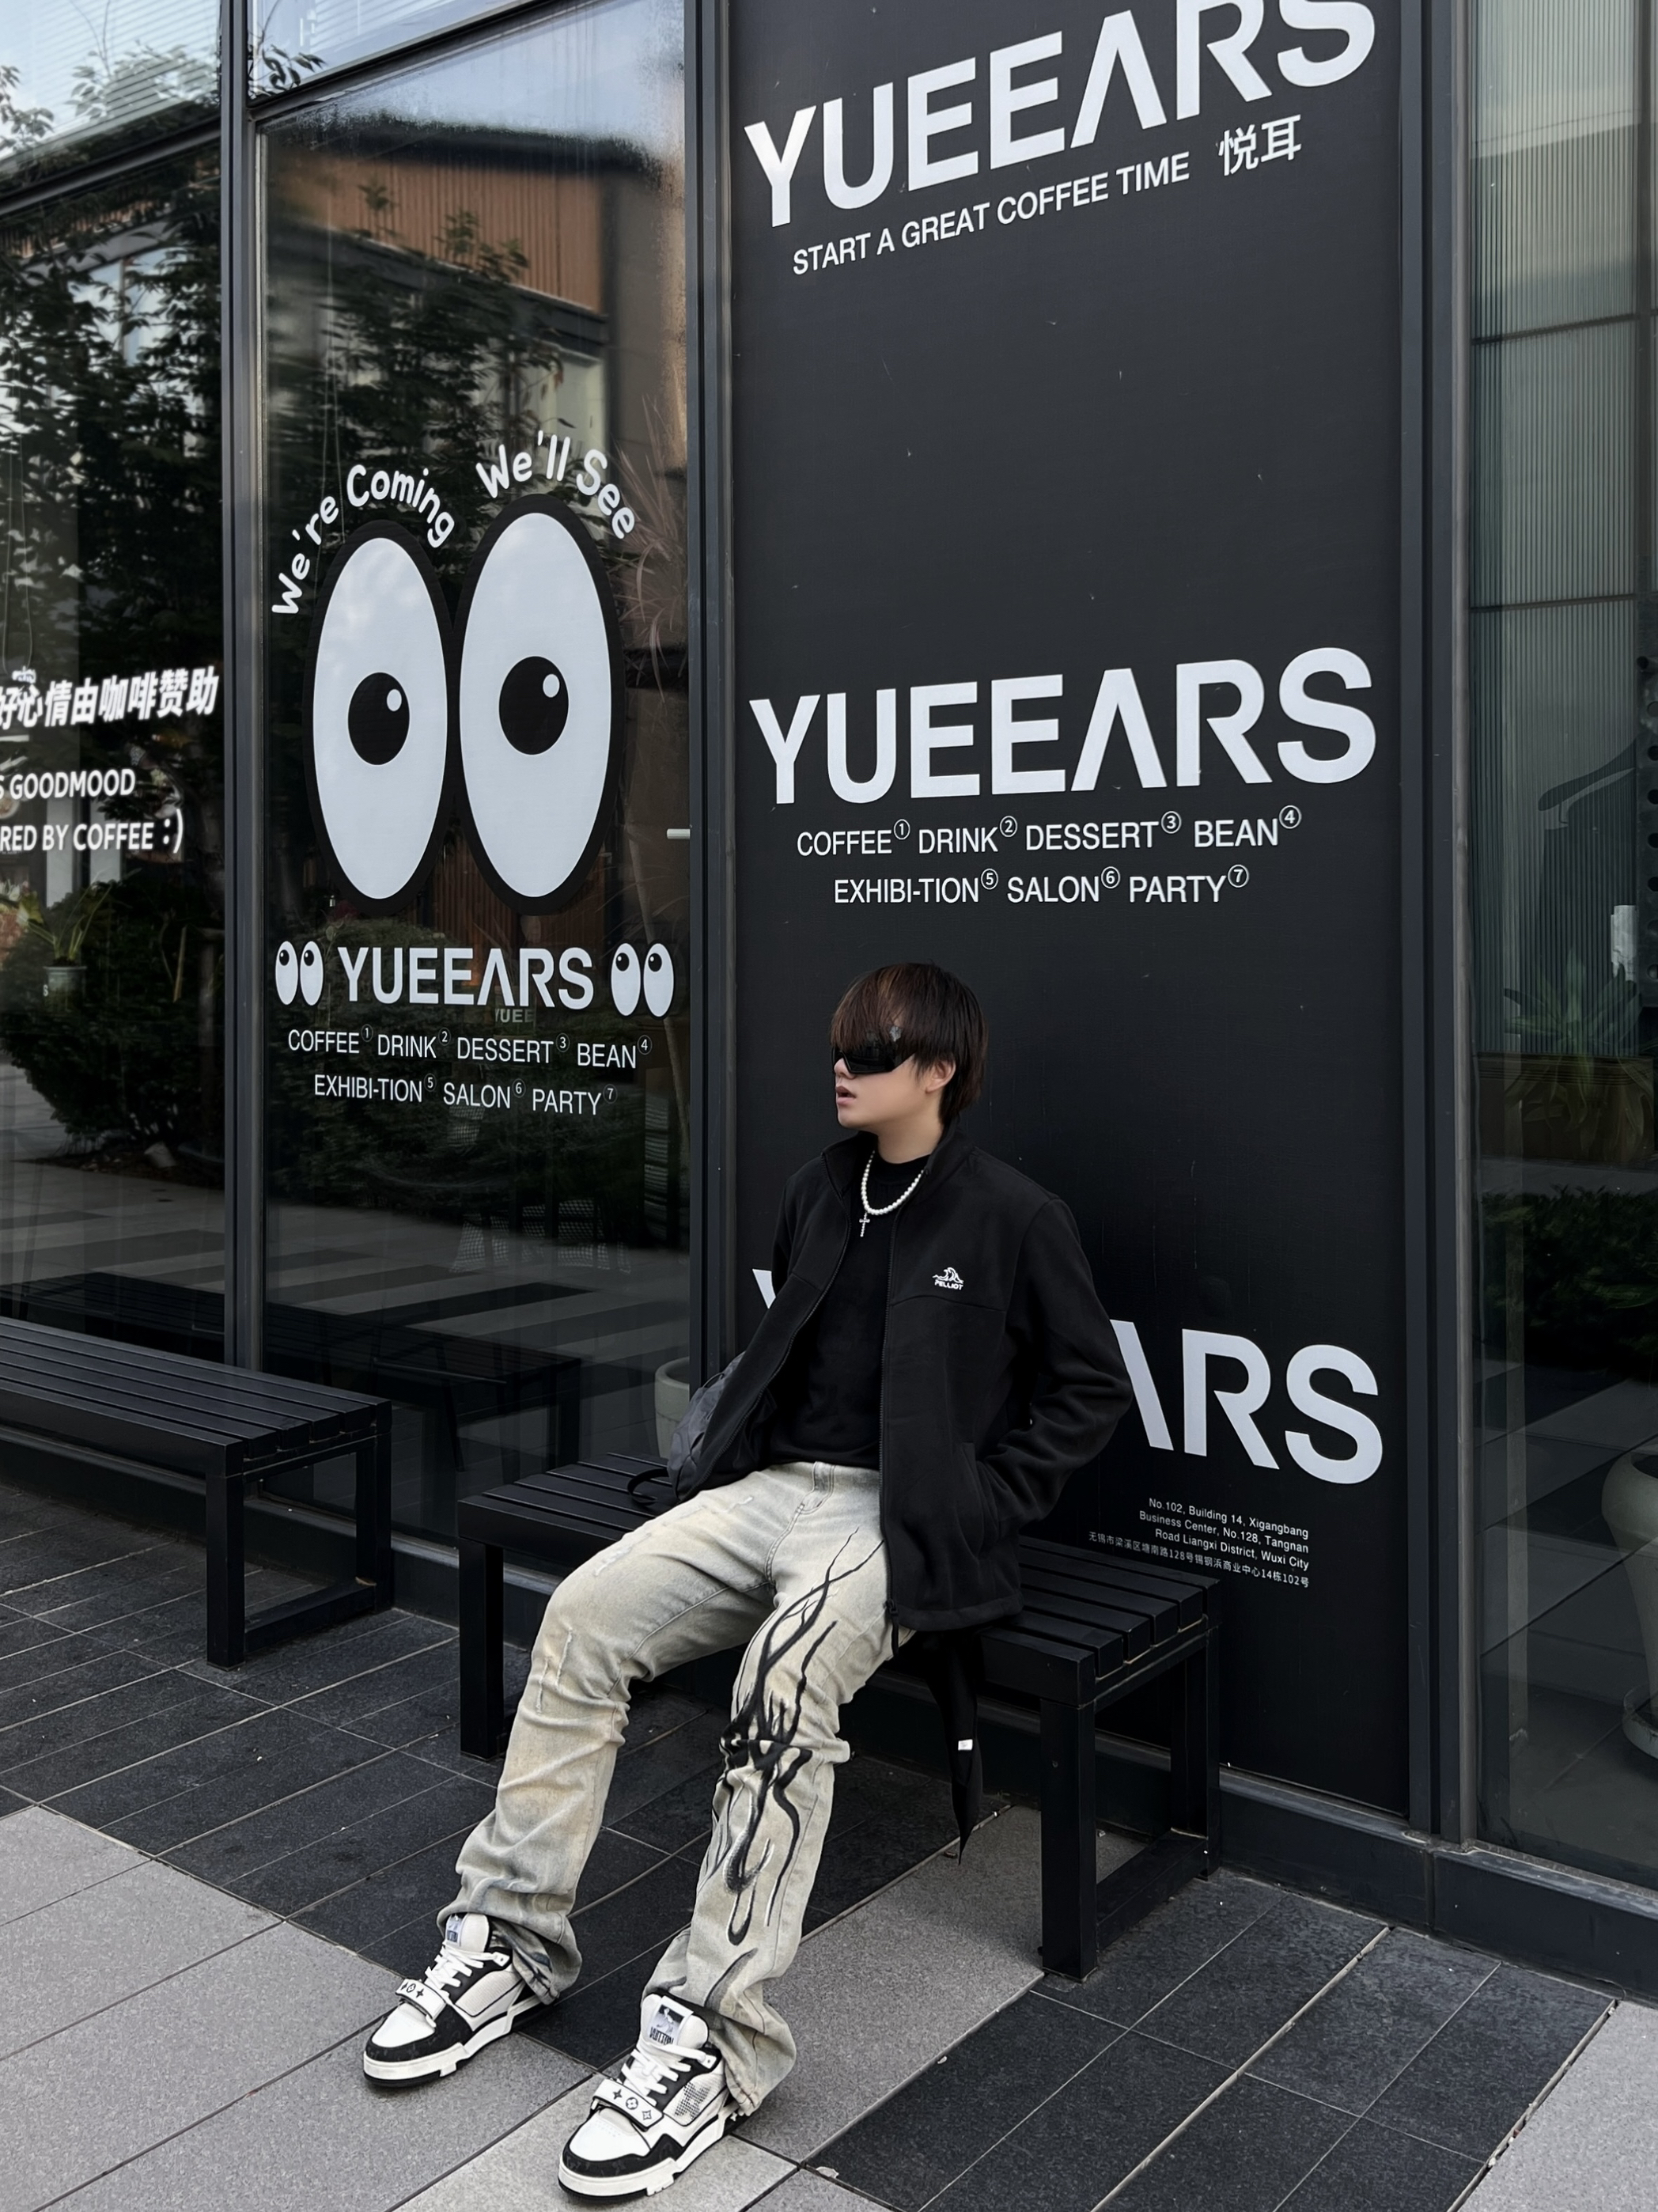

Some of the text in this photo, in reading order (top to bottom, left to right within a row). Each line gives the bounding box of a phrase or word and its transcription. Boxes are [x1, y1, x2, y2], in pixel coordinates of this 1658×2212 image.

[744, 0, 1376, 228] YUEEARS
[1217, 114, 1302, 176] 悦耳
[793, 151, 1190, 275] START A GREAT COFFEE TIME
[475, 430, 635, 540] We'll See
[271, 464, 455, 614] We're Coming
[748, 647, 1376, 805] YUEEARS
[9, 768, 136, 801] GOODMOOD
[42, 824, 70, 851] BY
[73, 822, 154, 851] COFFEE
[337, 946, 594, 1009] YUEEARS
[934, 1278, 964, 1291] PELLIOT
[1139, 1510, 1182, 1528] Business
[1184, 1519, 1221, 1537] Center,
[1264, 1535, 1309, 1554] Tangnan
[1155, 1528, 1310, 1572] Road Liangxi District, Wuxi City
[1189, 1505, 1228, 1525] Building
[1231, 1513, 1247, 1528] 14,
[1248, 1517, 1309, 1540] Xigangbang
